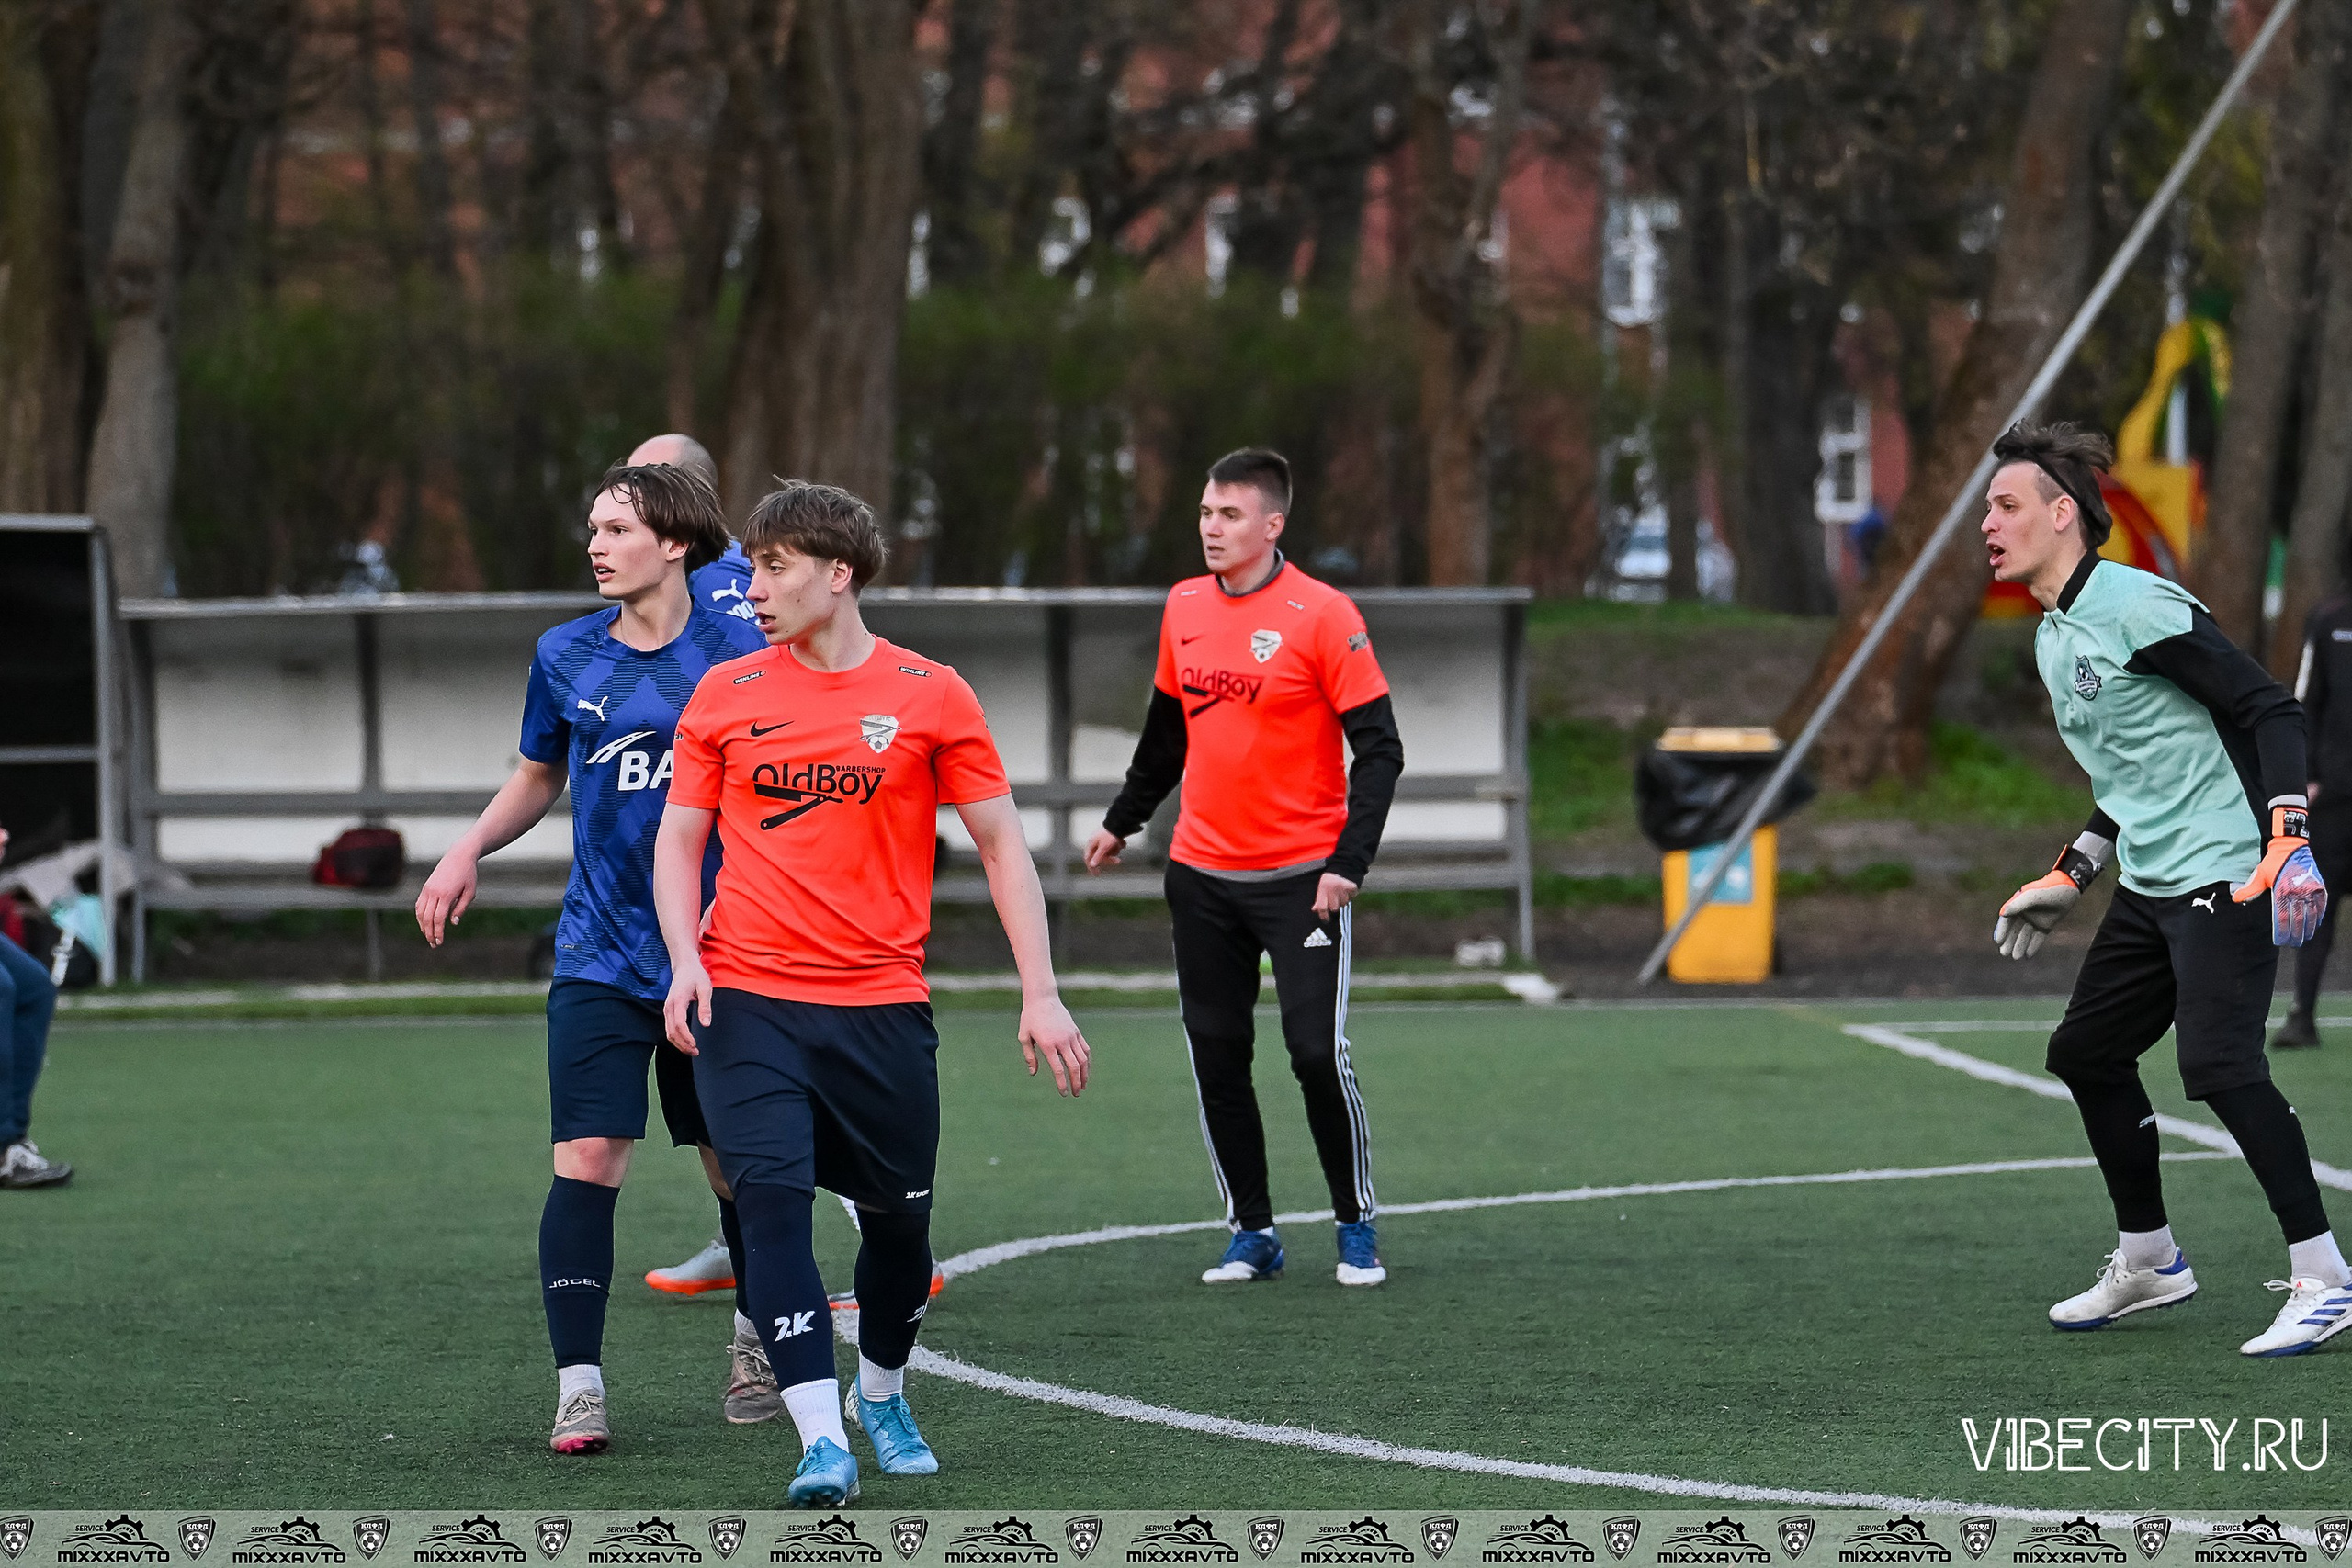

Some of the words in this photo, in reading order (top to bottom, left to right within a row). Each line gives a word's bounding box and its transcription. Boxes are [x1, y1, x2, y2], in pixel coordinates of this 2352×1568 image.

[1182, 667, 1262, 705] OldBoy
[752, 762, 883, 805] OldBoy
[835, 765, 886, 774] BARBERSHOP
[774, 1310, 816, 1342] 2K
